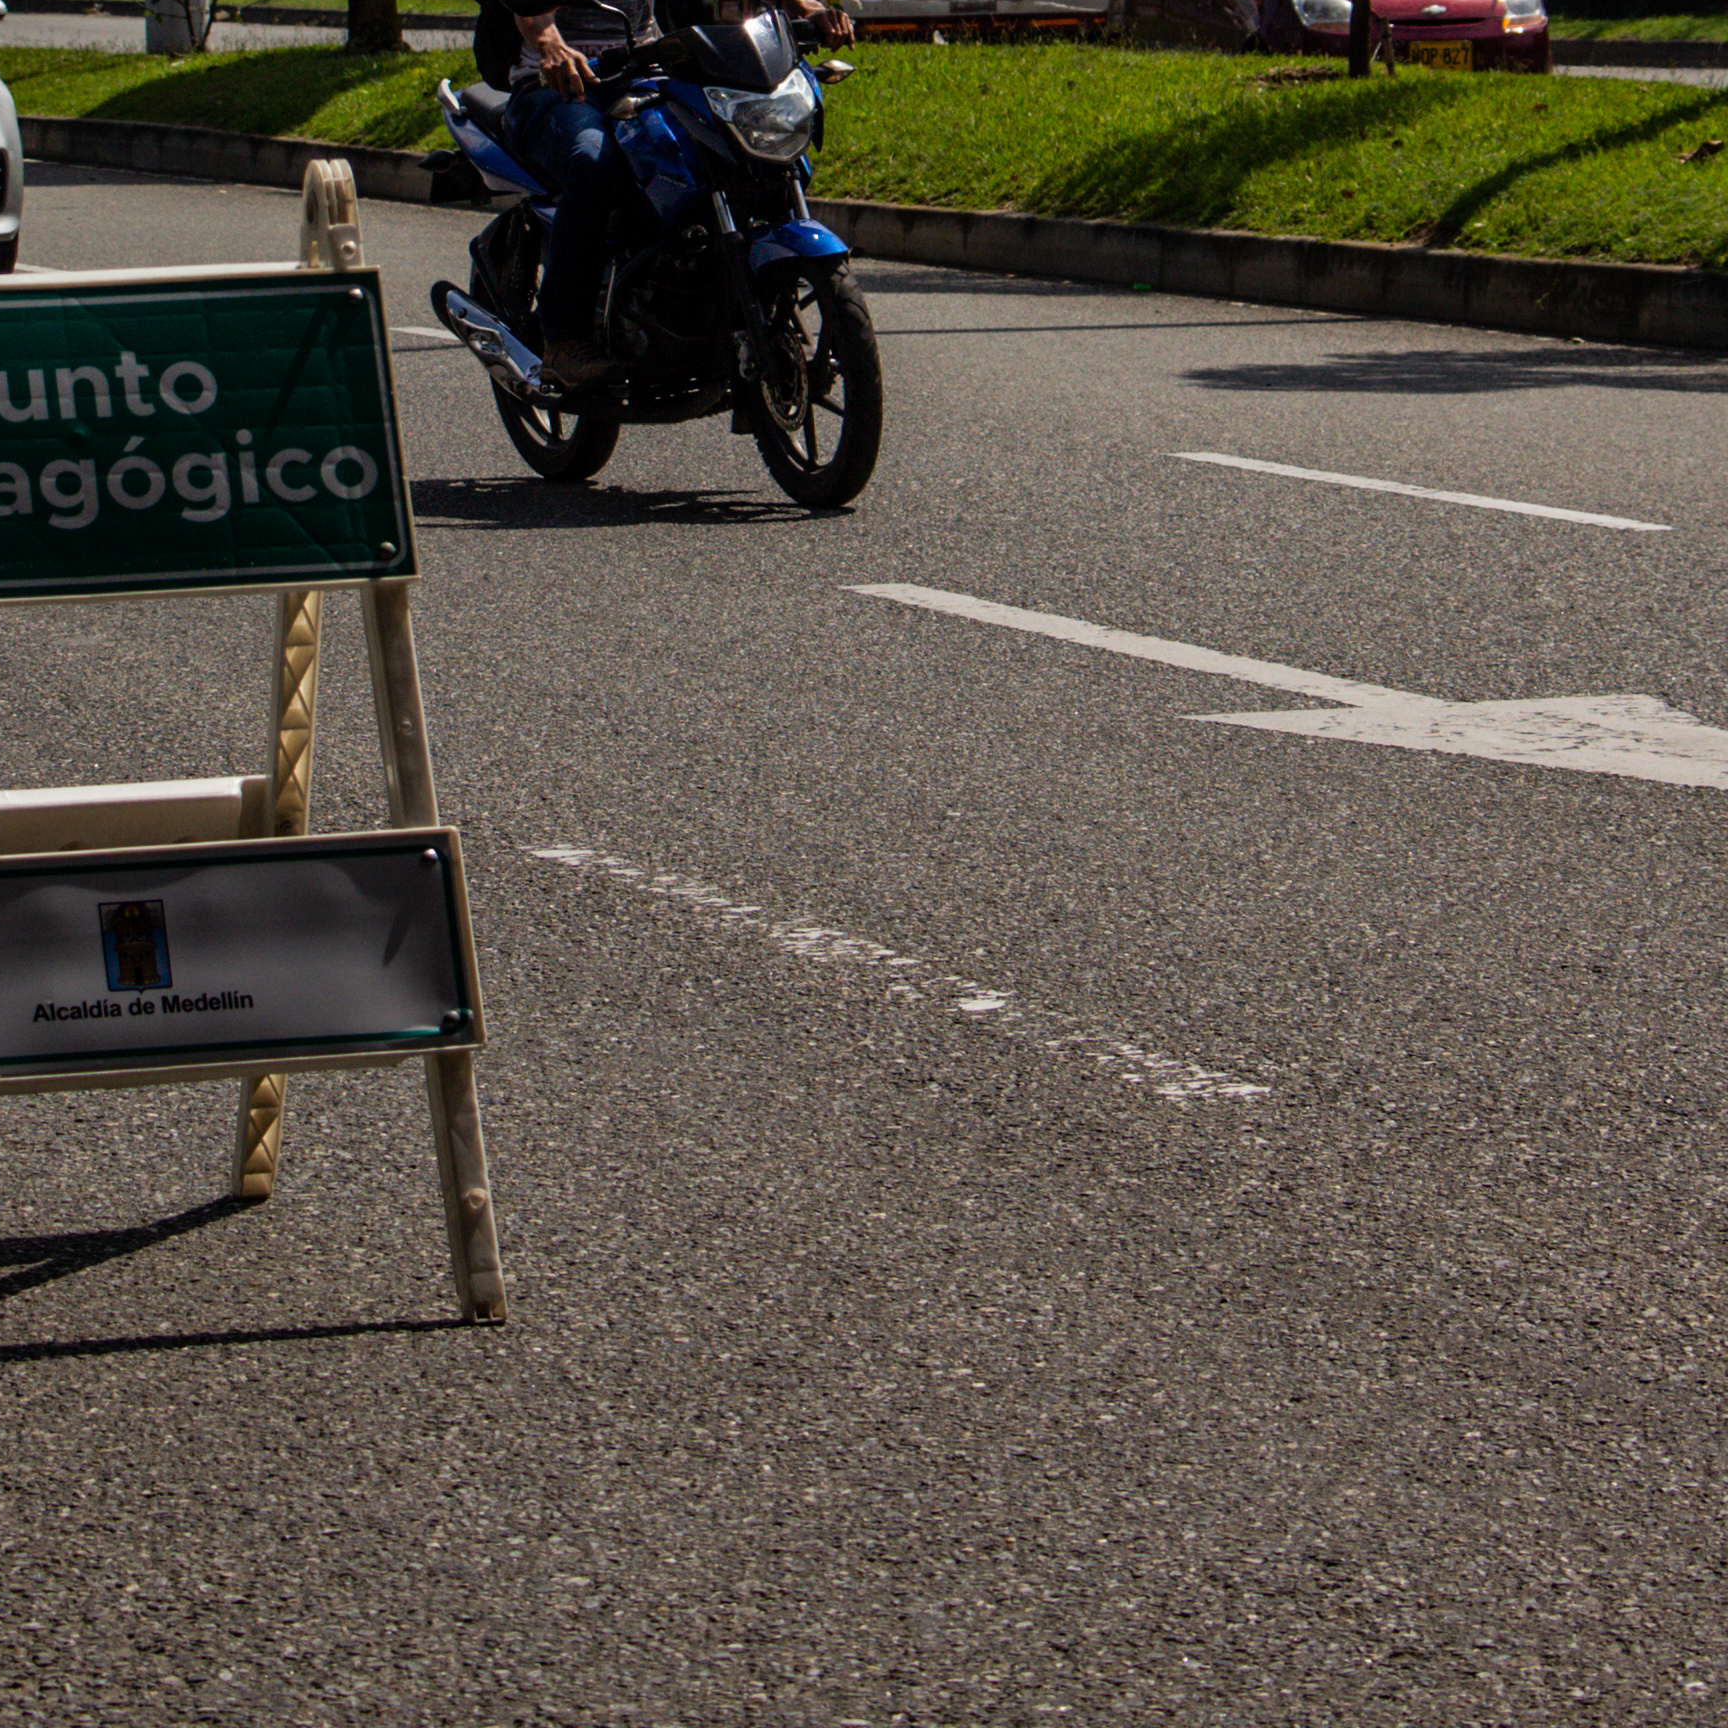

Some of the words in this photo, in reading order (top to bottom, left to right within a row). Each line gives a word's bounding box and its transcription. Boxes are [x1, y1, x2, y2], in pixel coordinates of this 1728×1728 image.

[32, 999, 122, 1023] Alcaldía
[128, 997, 155, 1017] de
[161, 990, 254, 1014] Medellín
